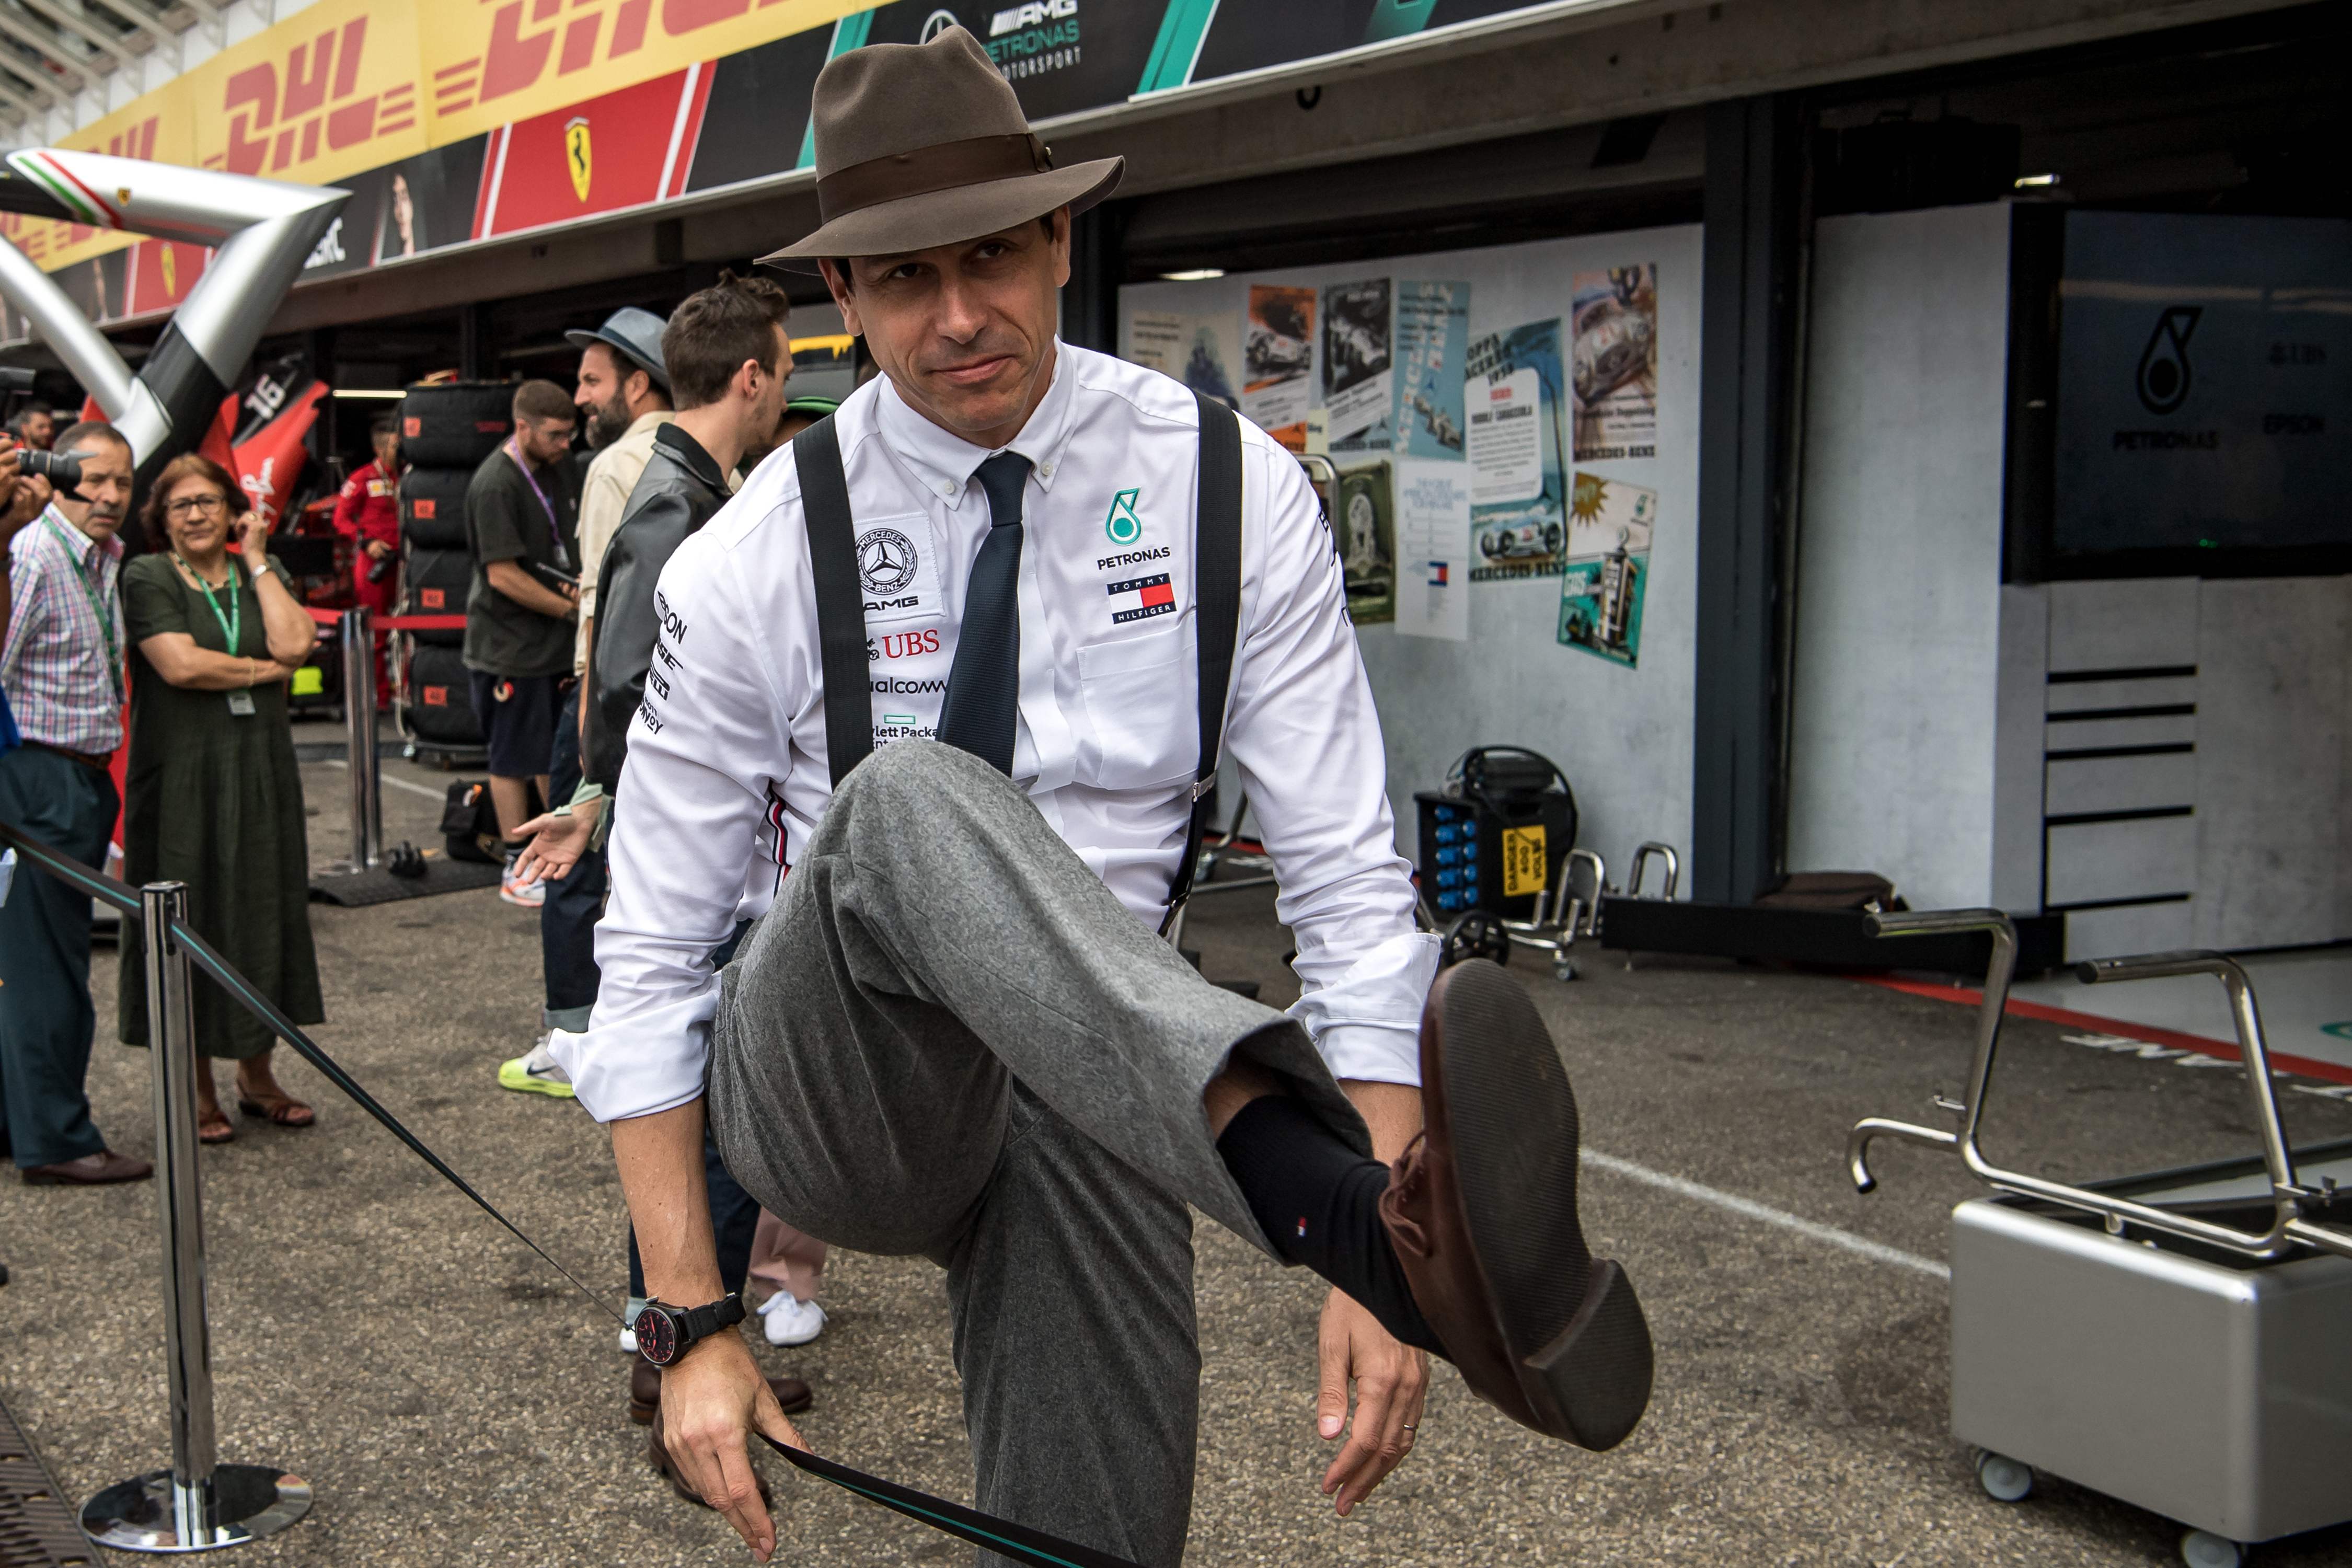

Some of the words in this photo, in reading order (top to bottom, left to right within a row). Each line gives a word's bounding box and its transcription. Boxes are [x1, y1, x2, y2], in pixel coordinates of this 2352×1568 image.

[982, 19, 1080, 63] ETRONAS
[1002, 45, 1081, 82] OTORSPORT
[224, 15, 379, 176] DHL
[244, 373, 286, 419] 16
[2113, 430, 2219, 451] PETRONAS
[860, 531, 902, 548] MERCEDES
[1097, 547, 1171, 570] PETRONAS
[875, 581, 900, 592] BENZ
[1113, 576, 1164, 591] TOMMY
[864, 595, 919, 612] AMG
[1117, 604, 1171, 621] HILFIGER
[881, 629, 940, 659] UBS
[870, 676, 946, 694] alcom
[873, 726, 898, 738] lett
[901, 727, 938, 738] Packa
